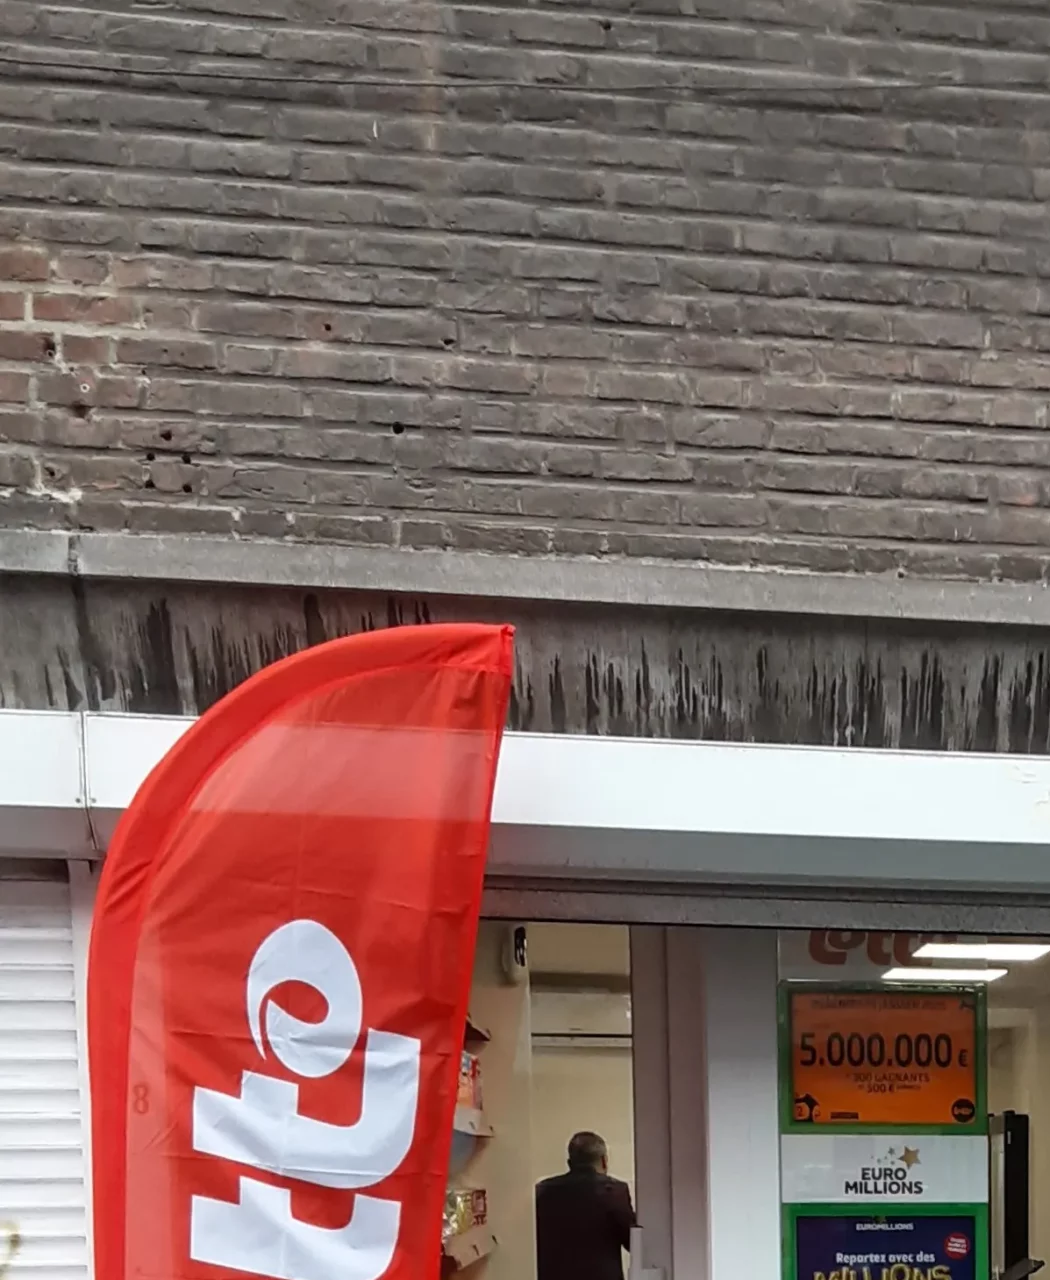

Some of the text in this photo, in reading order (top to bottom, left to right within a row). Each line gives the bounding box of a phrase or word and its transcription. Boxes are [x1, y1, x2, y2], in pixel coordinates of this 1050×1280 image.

[861, 1167, 907, 1181] EURO
[844, 1180, 923, 1195] MILLIONS
[855, 1222, 914, 1231] EUROMILLIONS
[836, 1250, 936, 1265] Repartez avec des
